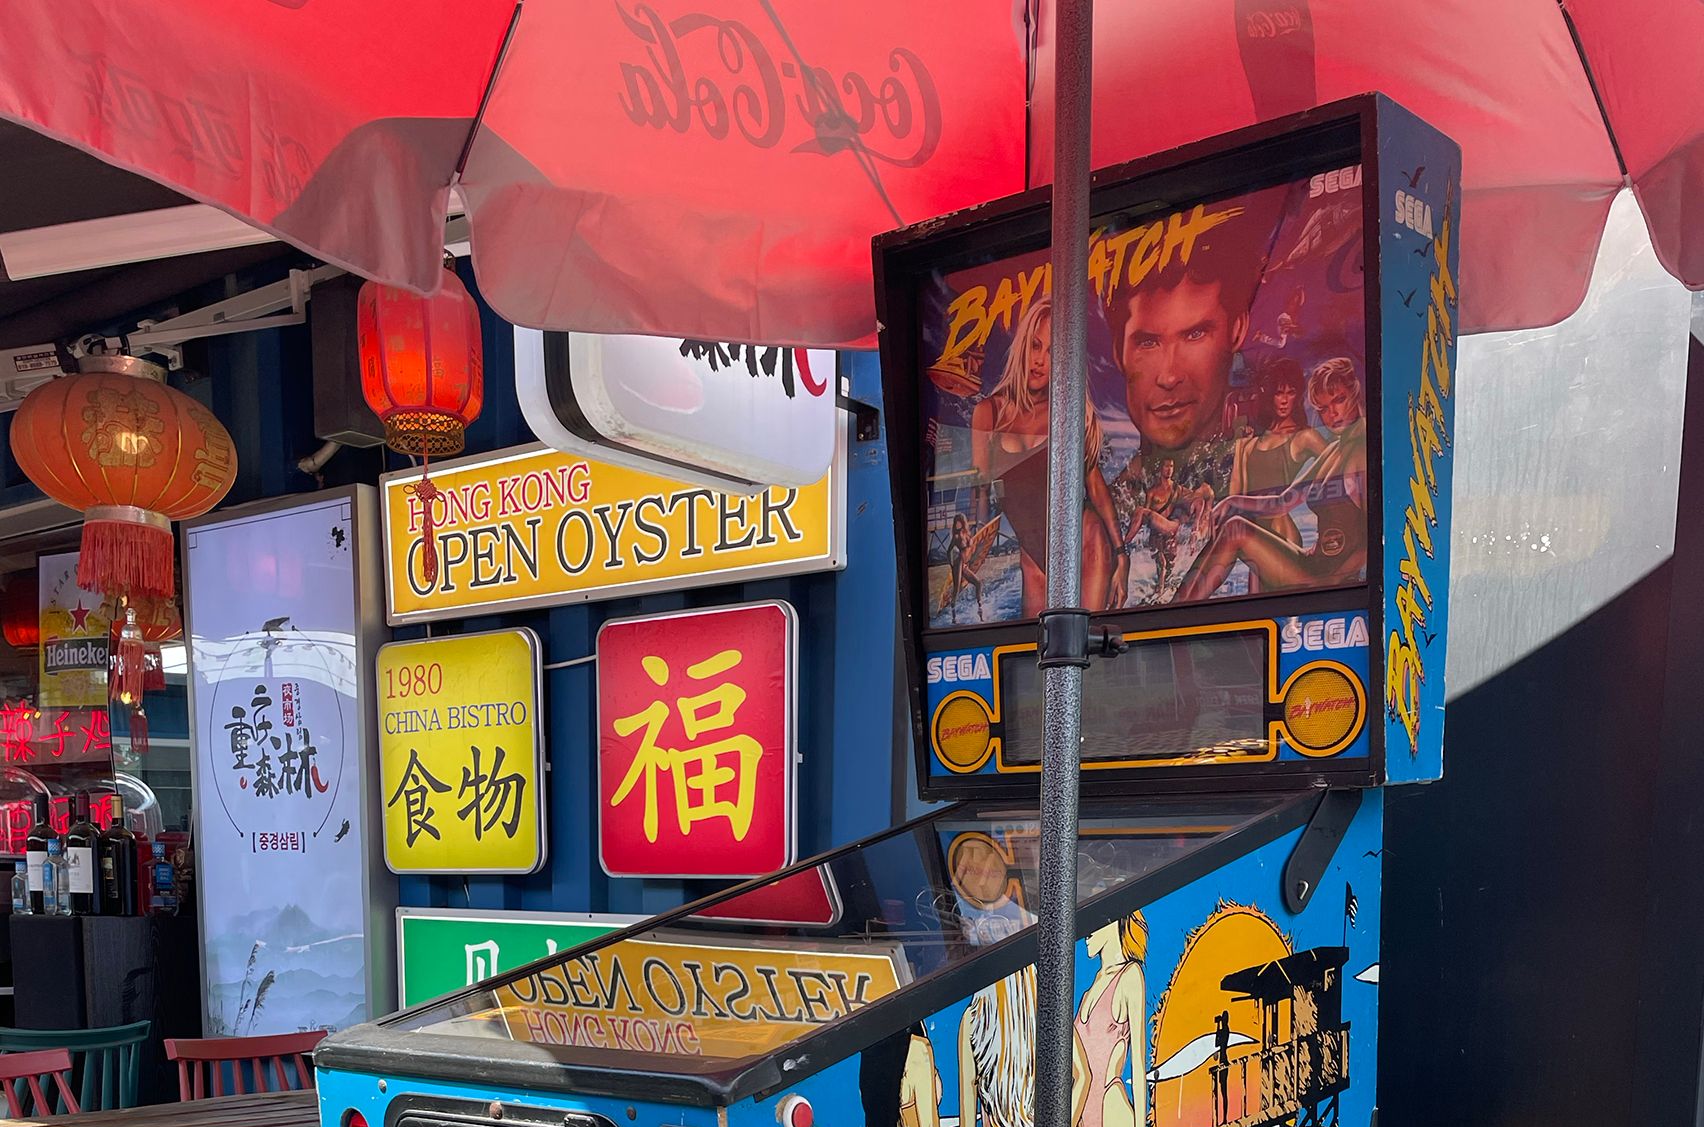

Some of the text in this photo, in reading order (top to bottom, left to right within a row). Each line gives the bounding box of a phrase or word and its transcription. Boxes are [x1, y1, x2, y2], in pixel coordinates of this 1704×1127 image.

[1395, 190, 1433, 240] SEGA
[928, 204, 1245, 369] BAYATCH
[408, 463, 590, 532] HONG KONG
[1386, 178, 1455, 765] BAYWATCH
[407, 488, 802, 597] OPEN OYSTER
[1281, 616, 1369, 653] SEGA
[384, 662, 443, 700] 1980
[927, 653, 991, 683] SEGA
[385, 702, 527, 734] CHINA BISTRO
[1290, 697, 1355, 720] BAYWATCH
[610, 648, 763, 843] 福
[387, 745, 527, 849] 食物
